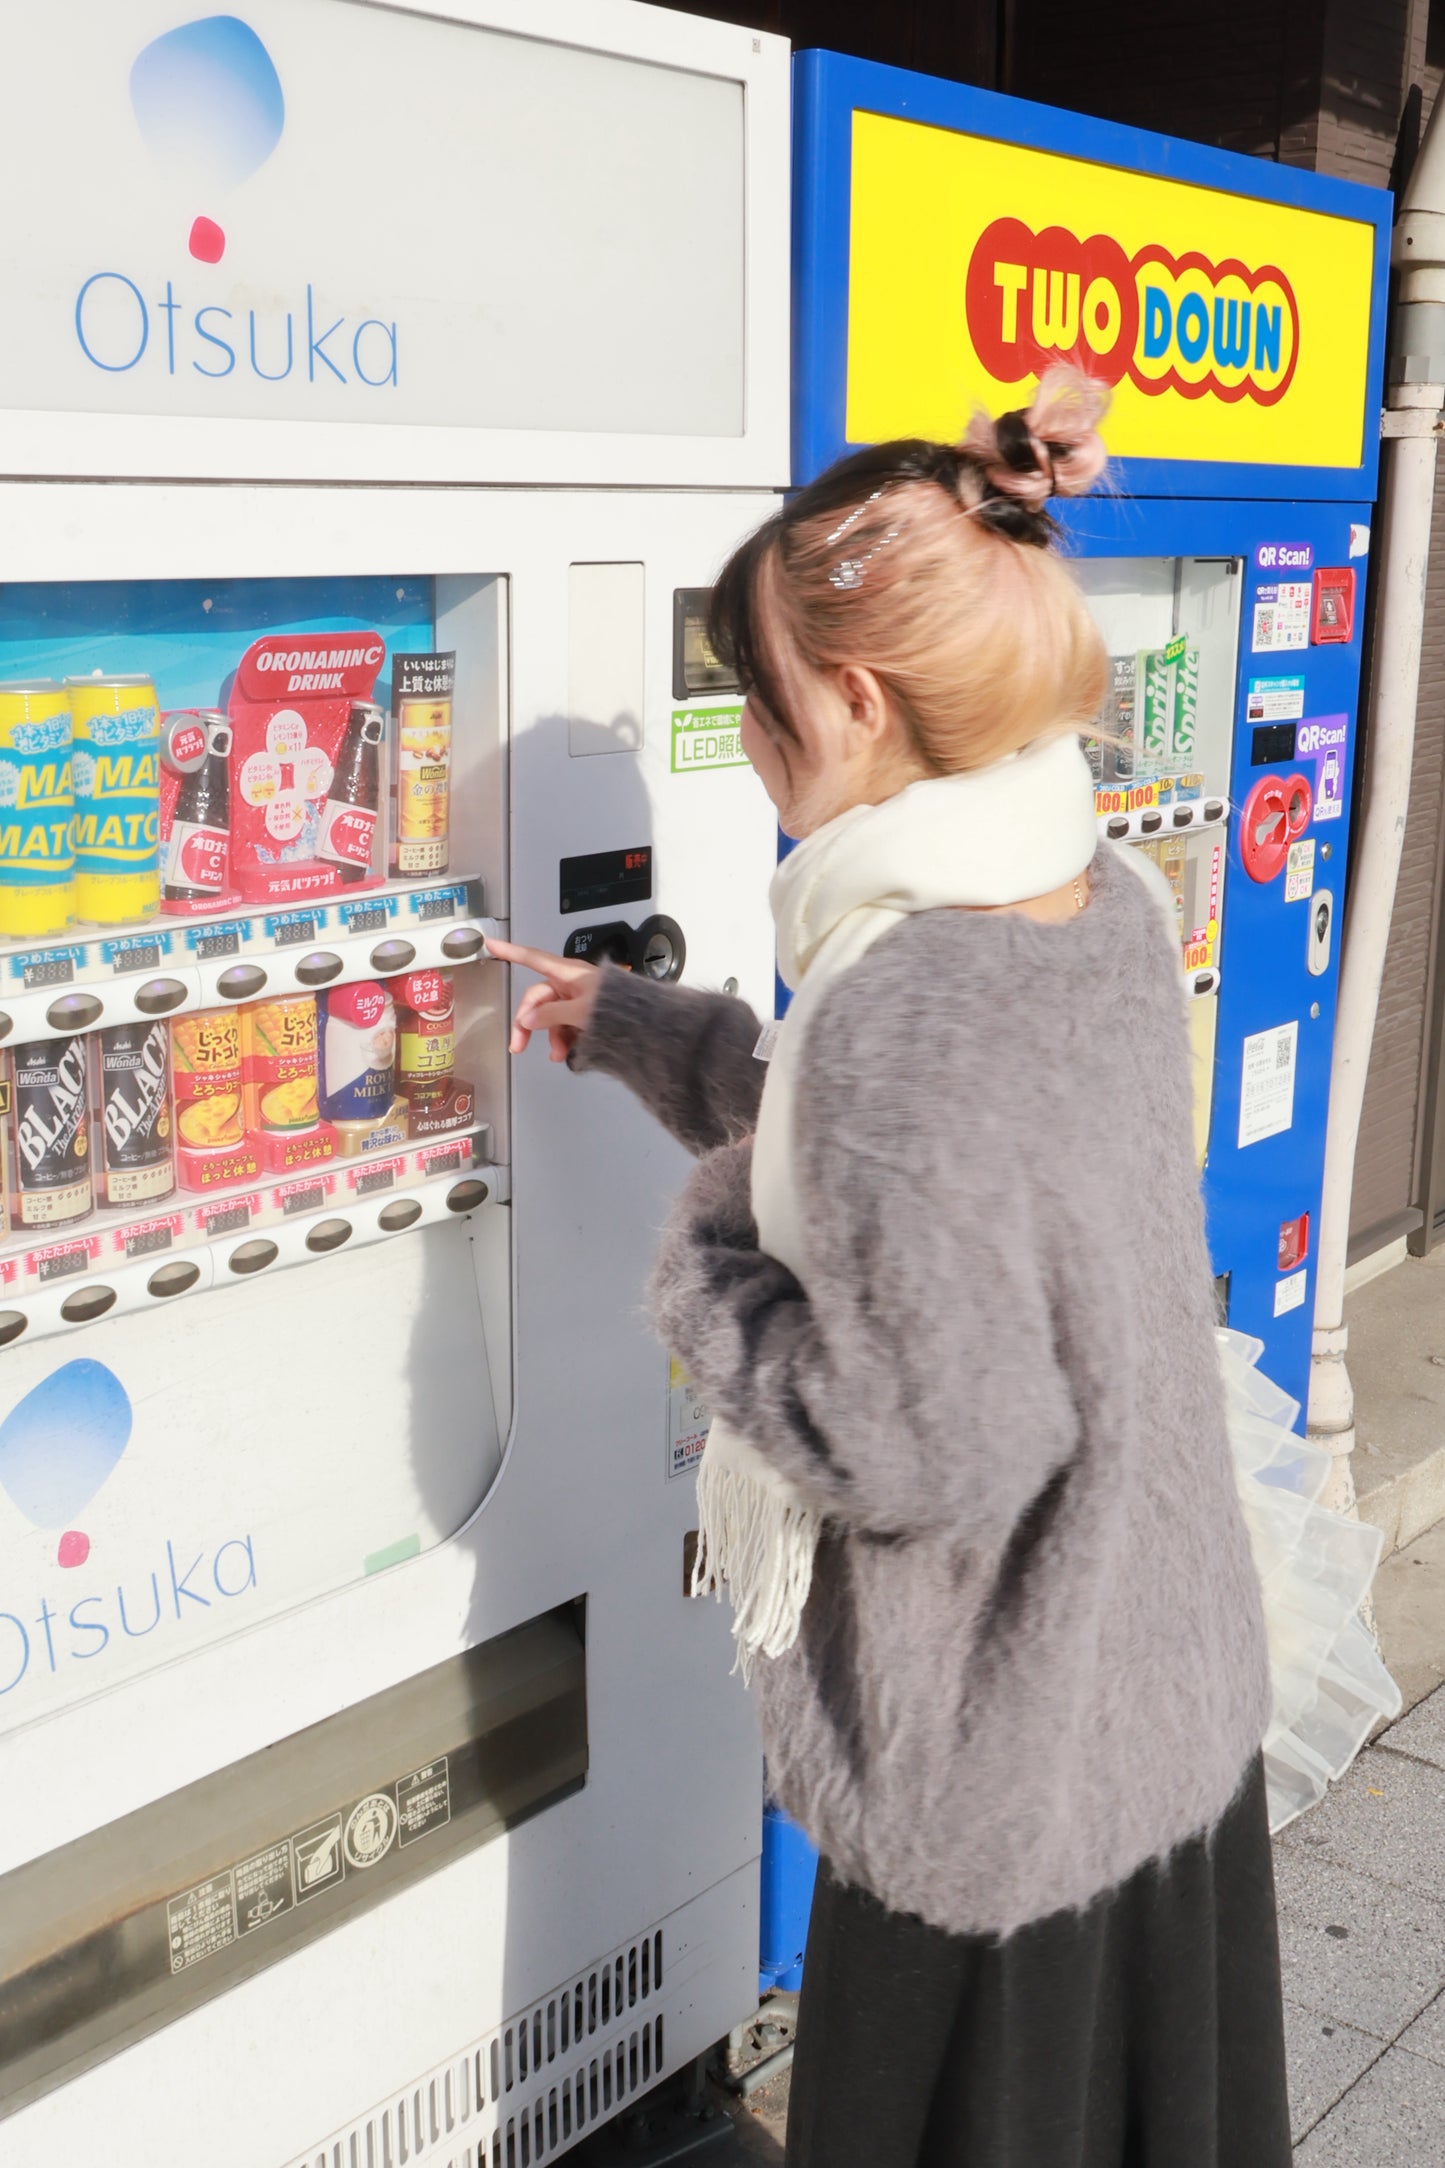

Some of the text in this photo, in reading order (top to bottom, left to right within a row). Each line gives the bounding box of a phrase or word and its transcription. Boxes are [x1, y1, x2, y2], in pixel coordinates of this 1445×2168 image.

[75, 272, 398, 387] Otsuka
[993, 261, 1282, 373] TWO DOWN
[1258, 546, 1311, 567] QR Scan!
[286, 672, 344, 693] DRINK
[1297, 725, 1347, 753] QR Scan!
